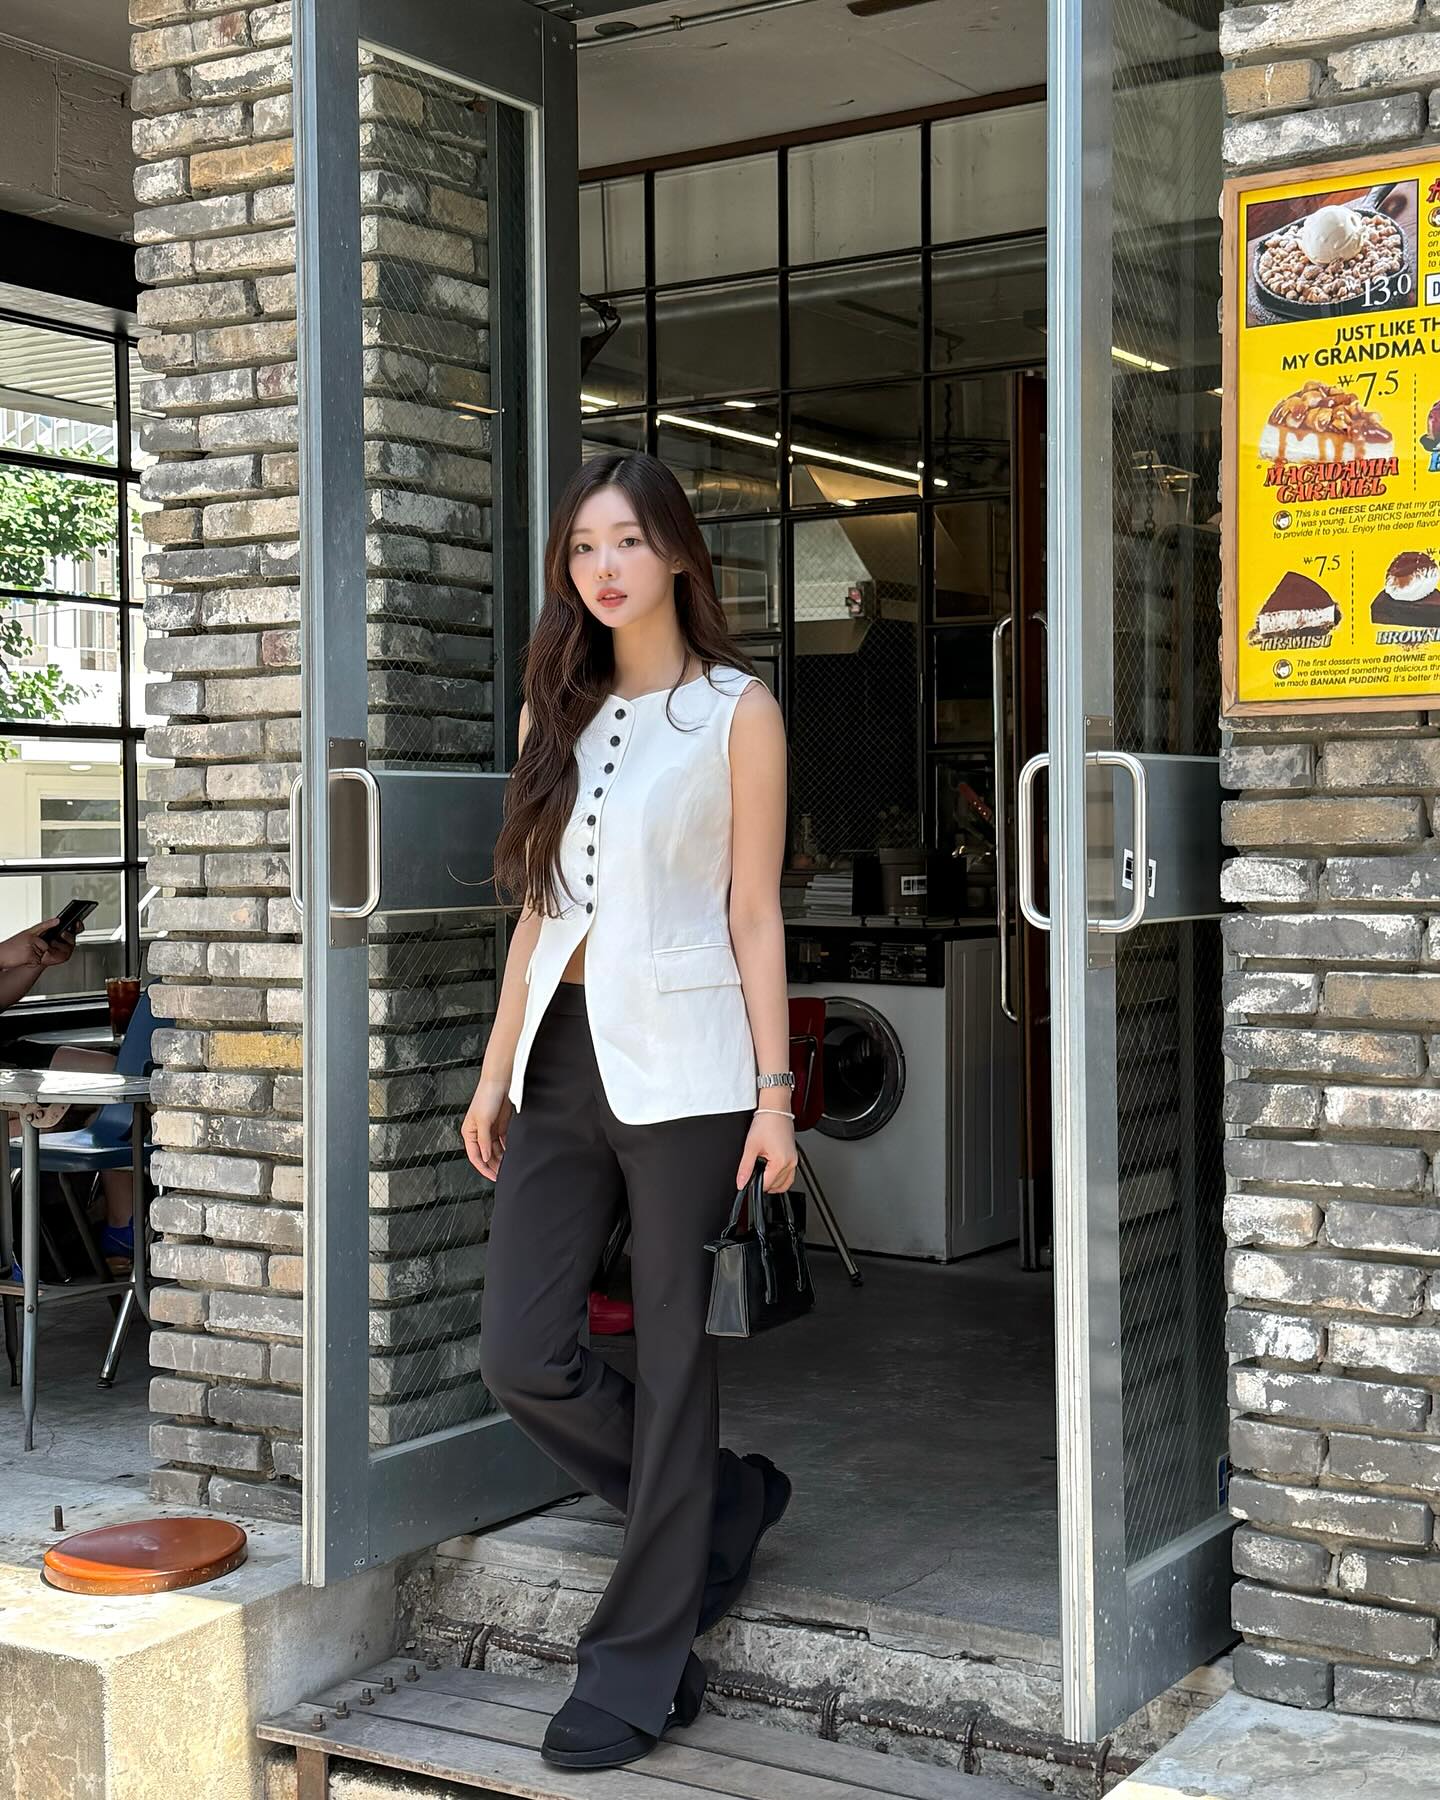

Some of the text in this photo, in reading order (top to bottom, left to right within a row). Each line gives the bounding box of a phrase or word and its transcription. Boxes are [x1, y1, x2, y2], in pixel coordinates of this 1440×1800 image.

[1336, 324, 1376, 345] JUST
[1380, 319, 1415, 337] LIKE
[1282, 353, 1310, 371] MY
[1315, 338, 1426, 366] GRANDMA
[1264, 457, 1399, 487] MACADAMIA
[1277, 478, 1387, 504] CARAMEL
[1296, 509, 1311, 518] This
[1312, 509, 1320, 517] is
[1329, 505, 1367, 516] CHEESE
[1368, 502, 1395, 513] CAKE
[1396, 501, 1413, 510] that
[1414, 501, 1427, 510] my
[1301, 520, 1317, 528] was
[1349, 514, 1366, 524] LAY
[1368, 511, 1402, 522] BRICKS
[1404, 509, 1436, 519] learned
[1273, 531, 1281, 539] to
[1283, 529, 1313, 540] provide
[1315, 528, 1321, 536] it
[1352, 524, 1376, 534] Enjoy
[1377, 522, 1391, 531] the
[1392, 521, 1415, 531] deep
[1415, 519, 1439, 528] flavor
[1260, 634, 1333, 651] TIRAMISU
[1297, 659, 1311, 668] The
[1312, 658, 1327, 667] first
[1328, 657, 1361, 666] desserts
[1362, 657, 1381, 665] were
[1383, 653, 1427, 663] BROWNIE
[1287, 679, 1309, 687] made
[1310, 676, 1346, 686] BANANA
[1407, 673, 1431, 682] better
[1309, 668, 1350, 677] developed
[1351, 665, 1392, 675] something
[1393, 664, 1428, 673] delicious
